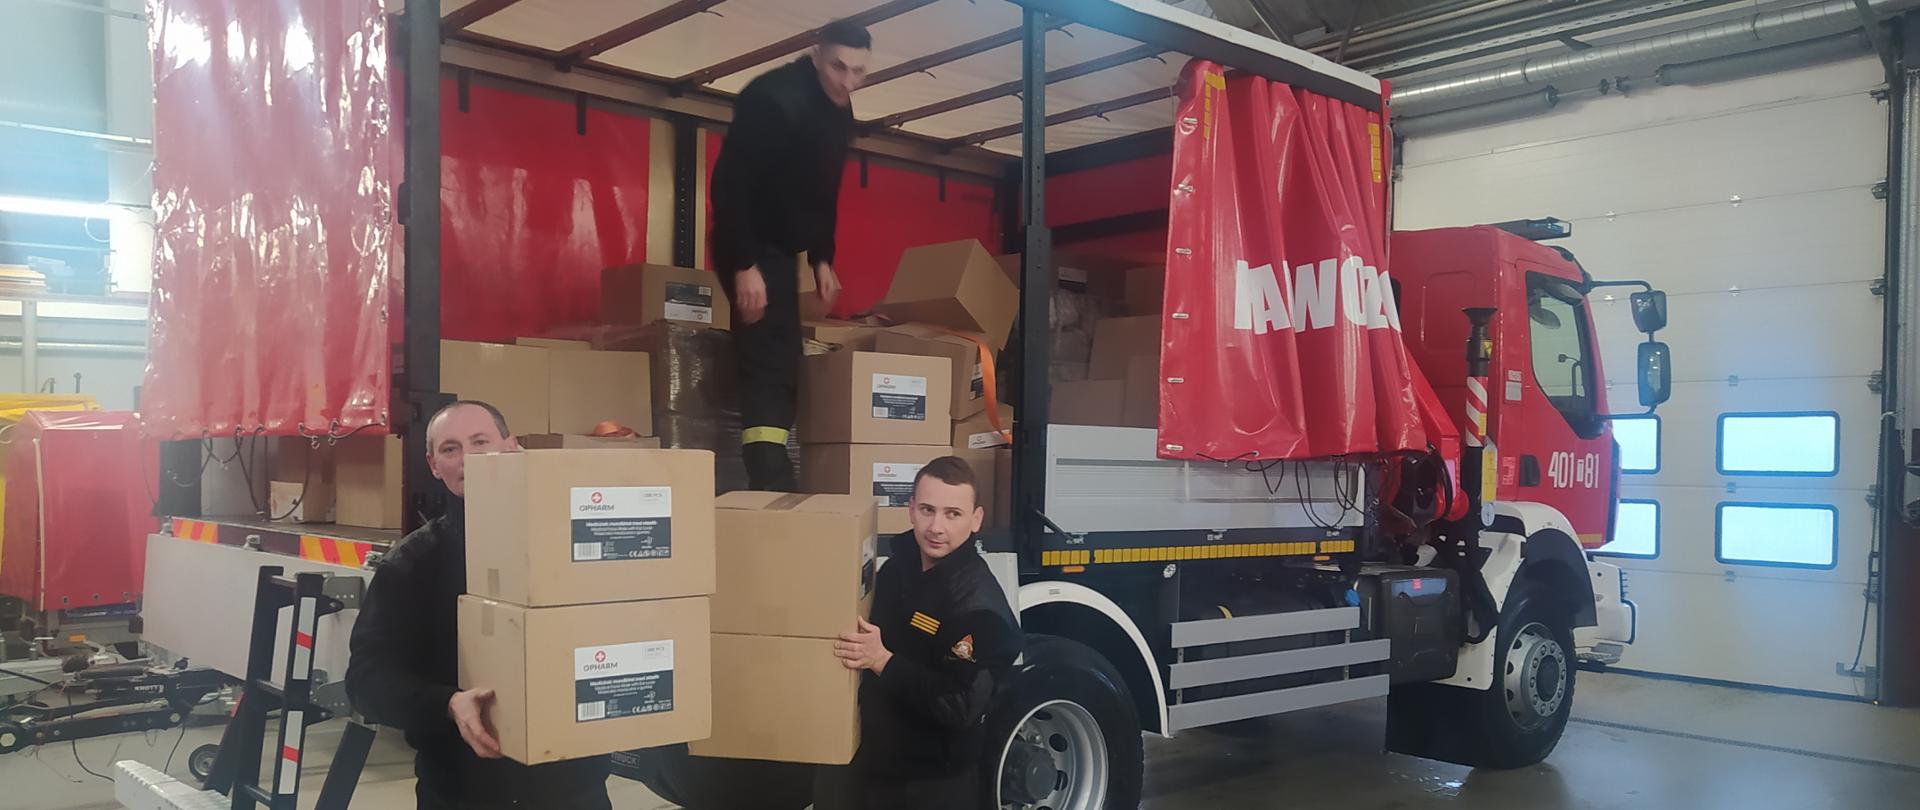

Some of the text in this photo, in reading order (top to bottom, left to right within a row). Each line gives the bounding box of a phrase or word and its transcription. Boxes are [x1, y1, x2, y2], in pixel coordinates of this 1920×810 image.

[1548, 451, 1574, 488] 401
[1585, 453, 1600, 488] 81
[579, 504, 615, 512] OPHARM
[583, 662, 618, 672] OPHARM
